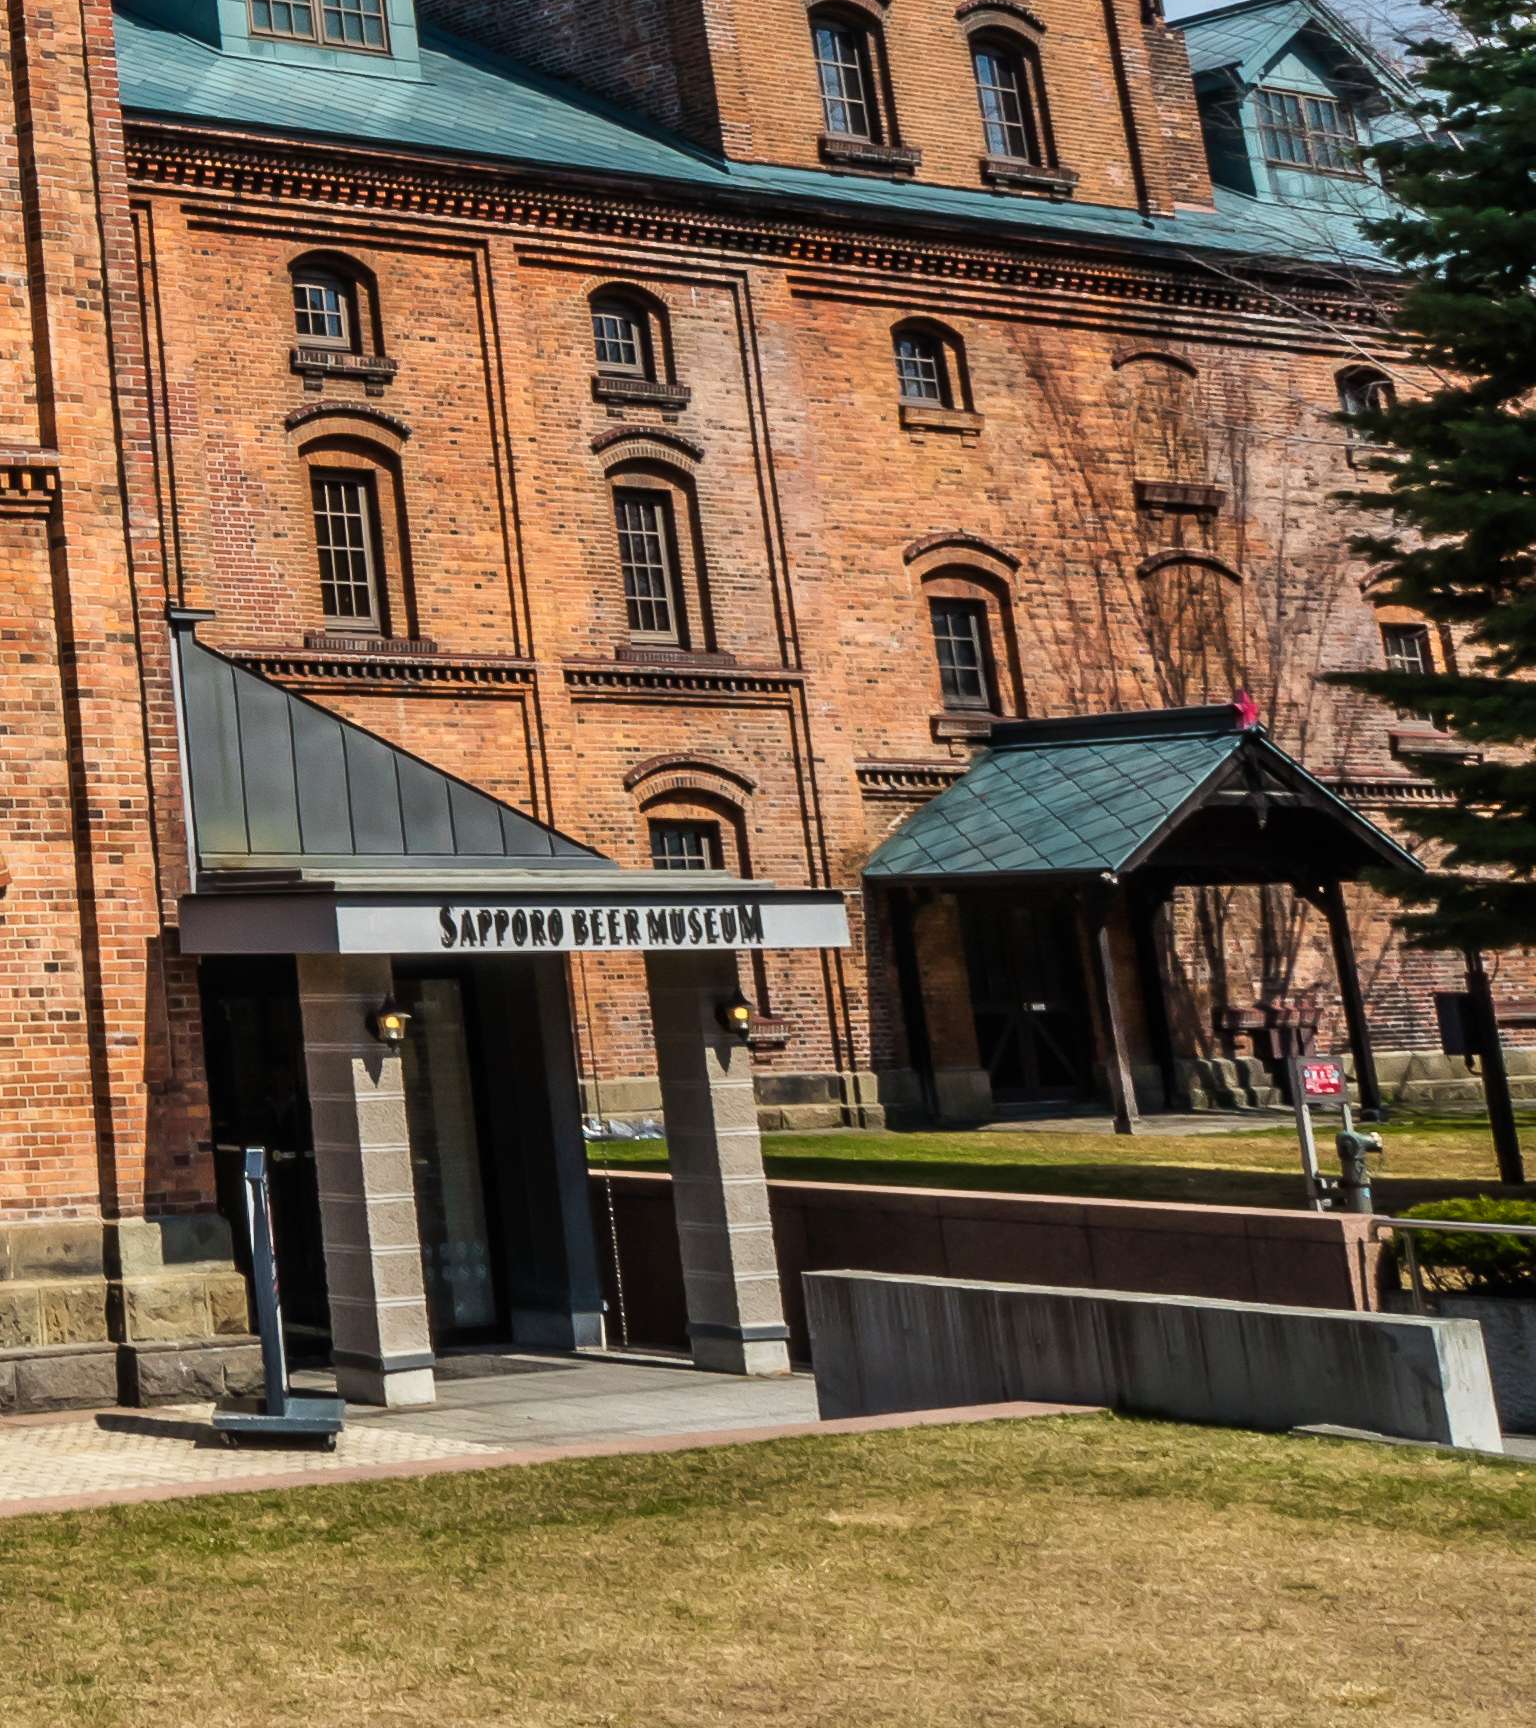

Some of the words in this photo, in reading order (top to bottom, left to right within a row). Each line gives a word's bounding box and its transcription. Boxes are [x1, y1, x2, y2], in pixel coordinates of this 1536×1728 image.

[439, 906, 564, 948] SAPPORO
[571, 908, 642, 946] BEER
[645, 904, 765, 945] MUSEUM
